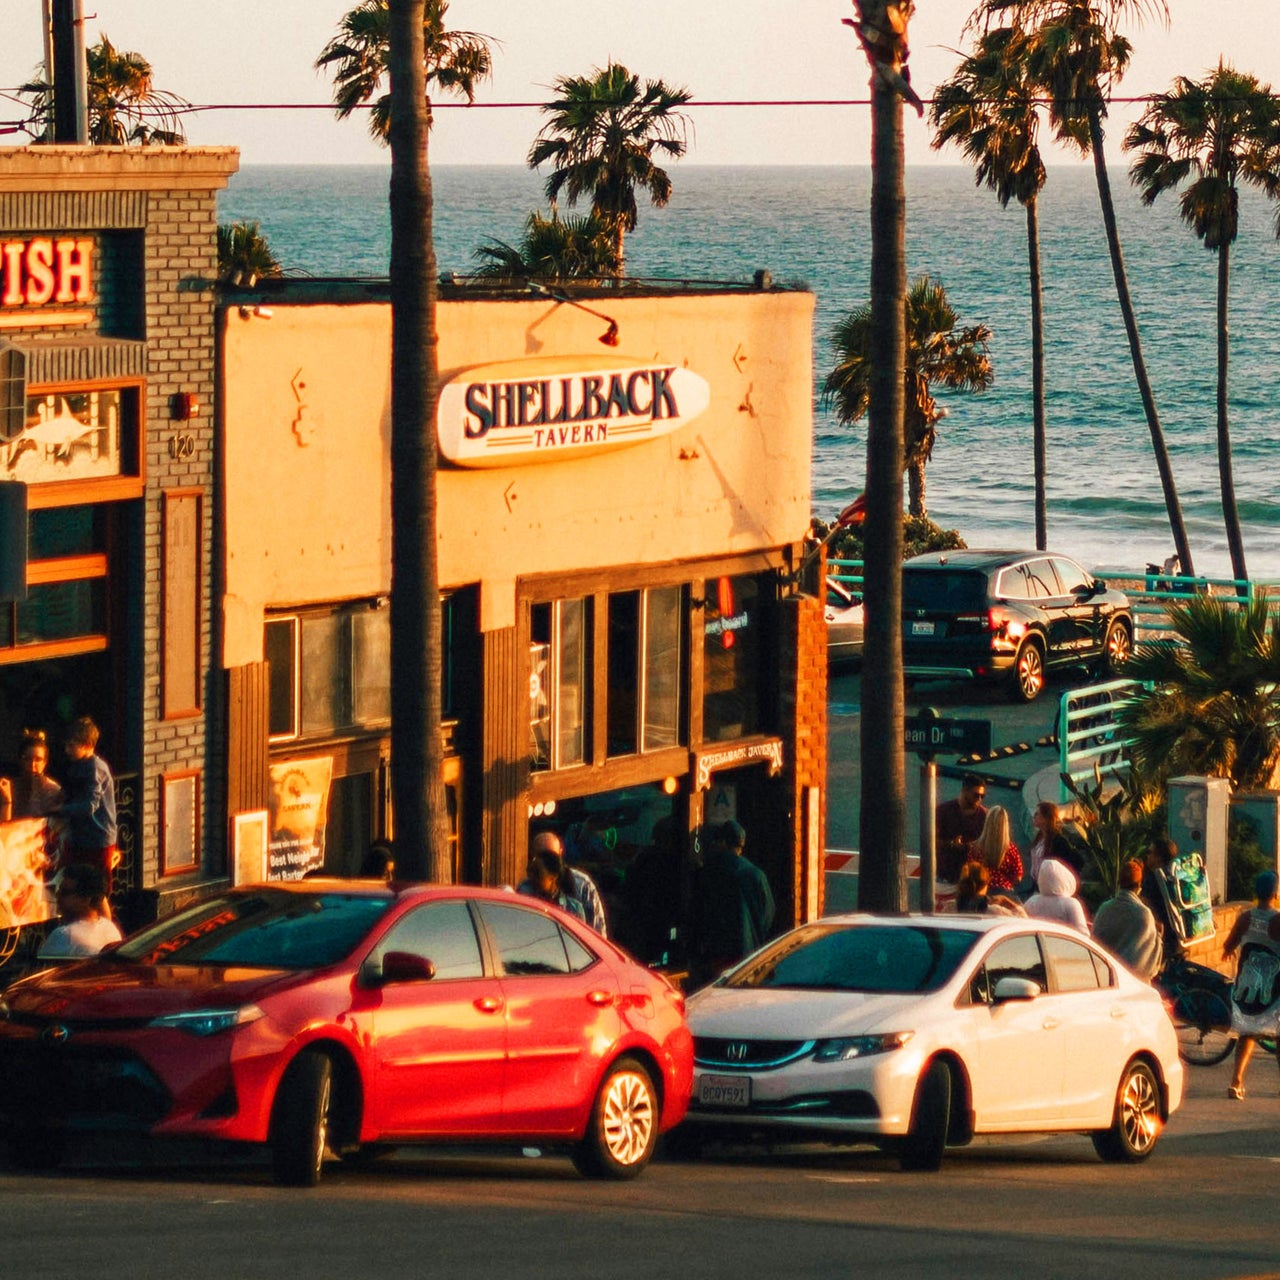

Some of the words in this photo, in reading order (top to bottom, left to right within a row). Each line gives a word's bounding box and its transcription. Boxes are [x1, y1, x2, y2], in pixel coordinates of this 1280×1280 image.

[463, 366, 680, 439] SHELLBACK
[168, 435, 195, 459] 120
[534, 423, 608, 448] TAVERN
[931, 726, 945, 744] Dr
